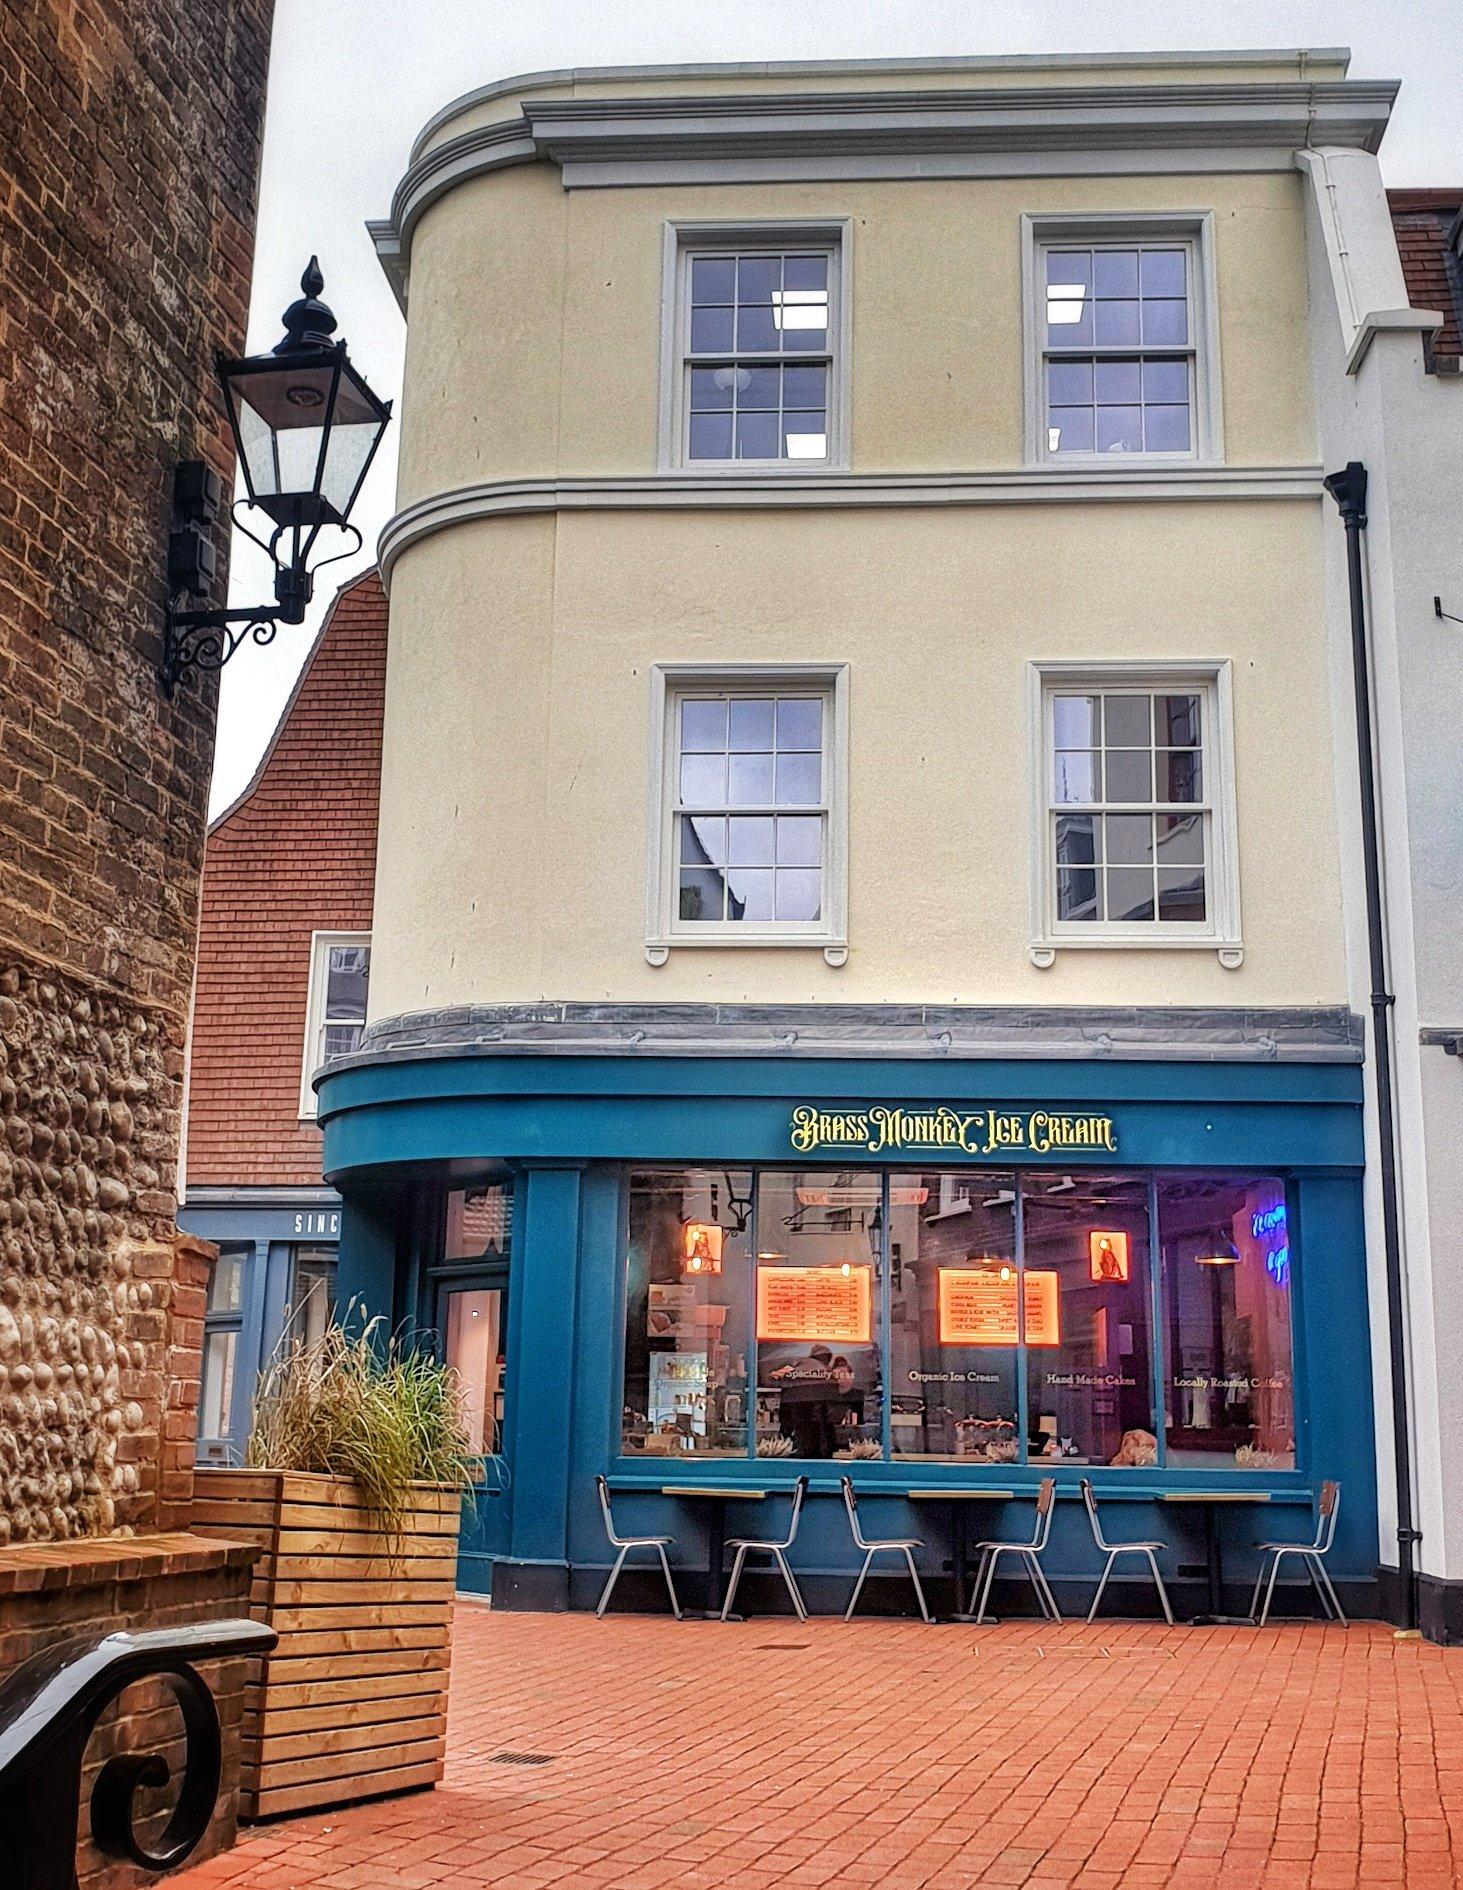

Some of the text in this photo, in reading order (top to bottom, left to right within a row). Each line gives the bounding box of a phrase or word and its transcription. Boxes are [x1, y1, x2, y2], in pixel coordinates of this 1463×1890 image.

[790, 1105, 1117, 1154] BRASS MONKEY ICE CREAM
[908, 1370, 1000, 1383] Organic Ice Cream
[1046, 1373, 1136, 1386] Hand Made Cakes
[1173, 1376, 1283, 1389] Locally Roasted Coffee
